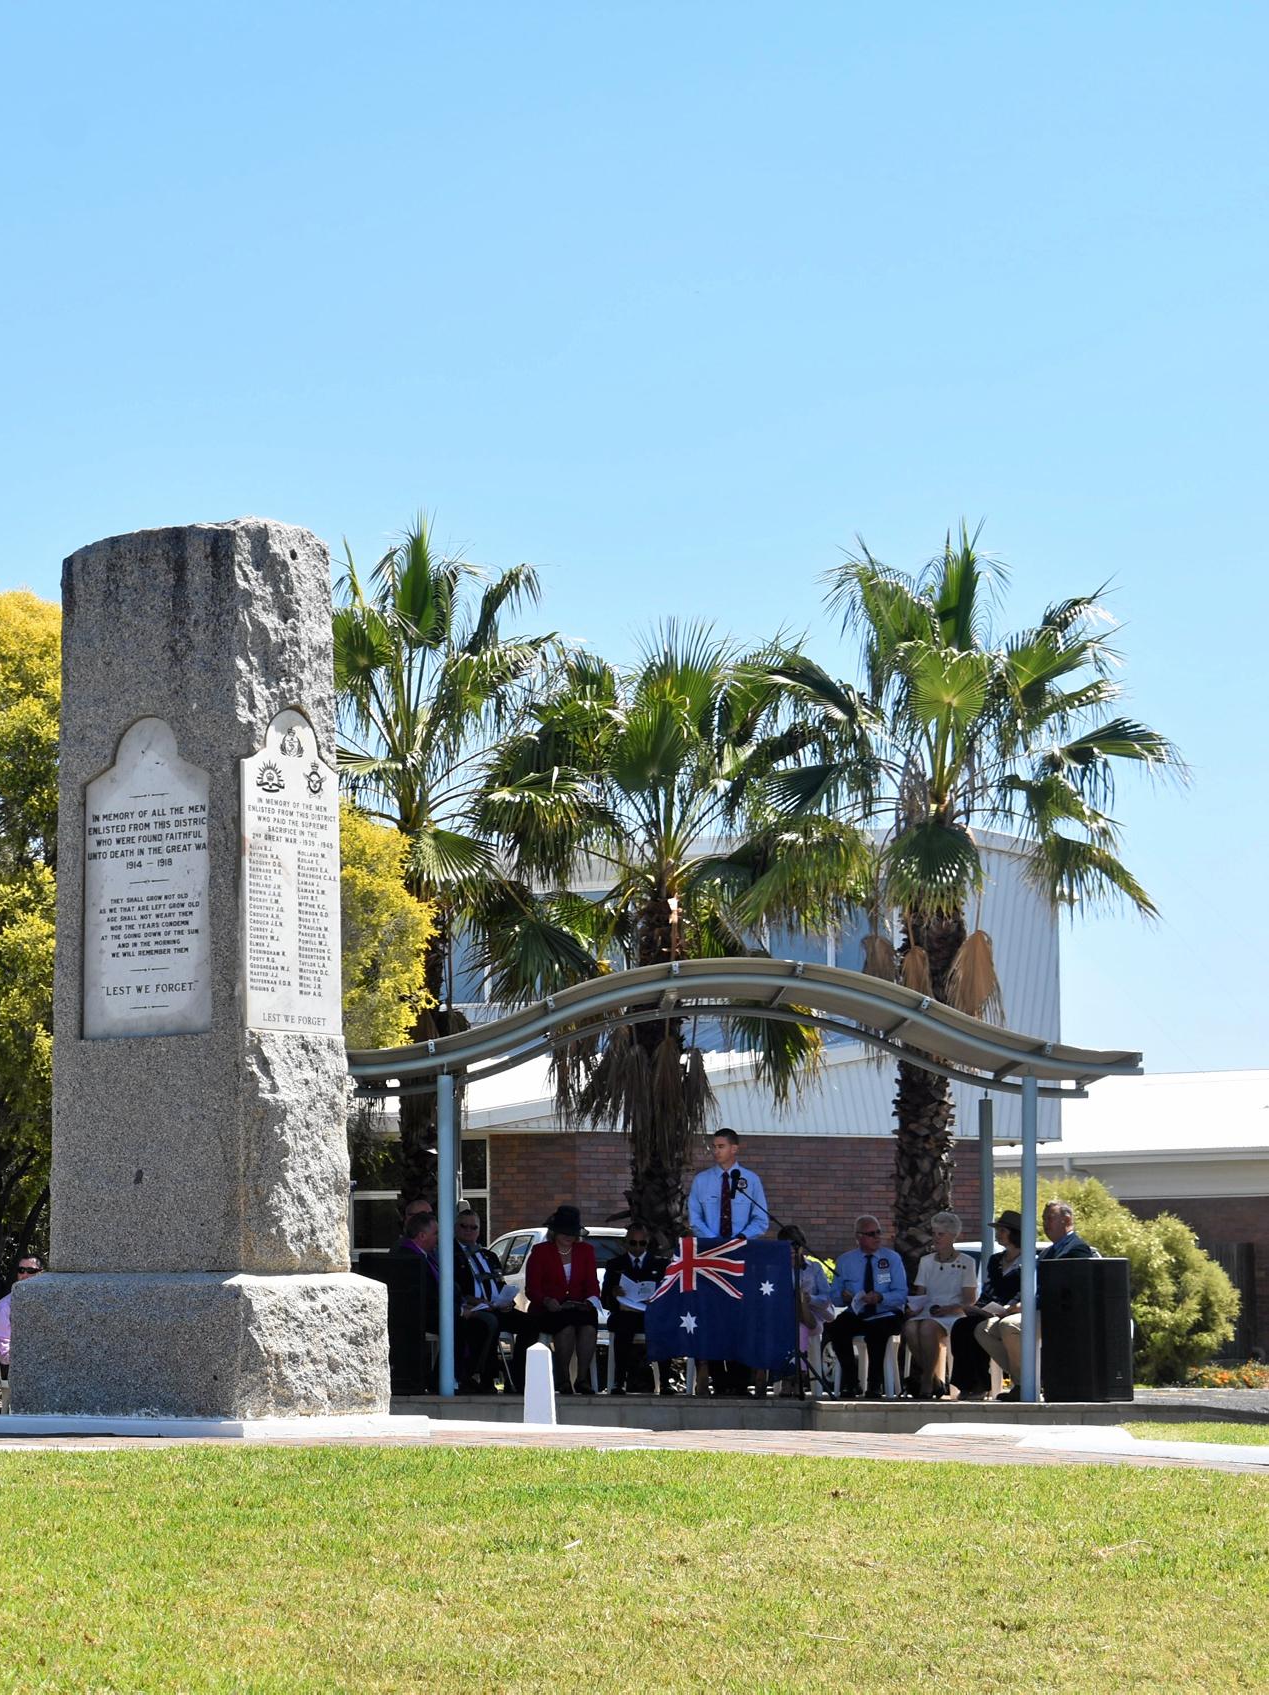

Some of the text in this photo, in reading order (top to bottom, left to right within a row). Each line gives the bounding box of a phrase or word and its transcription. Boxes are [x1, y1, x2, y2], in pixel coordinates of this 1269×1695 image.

[266, 798, 289, 807] MEMORY
[92, 814, 99, 822] IN
[102, 811, 134, 821] MEMORY
[138, 810, 147, 818] OF
[170, 806, 184, 815] THE
[188, 804, 205, 813] MEN
[248, 805, 275, 814] ENLISTED
[296, 811, 308, 819] THIS
[311, 814, 335, 822] DISTRICT
[88, 817, 207, 835] ENLISTED FROM THIS DISTRIC
[268, 826, 296, 835] SACRIFICE
[302, 821, 327, 830] SUPREME
[96, 831, 202, 846] WHO WERE FOUND FAITHFUL
[264, 834, 282, 842] GREAT
[88, 852, 107, 860] UNTO
[110, 849, 134, 858] DEATH
[137, 848, 144, 856] IN
[148, 846, 162, 855] THE
[165, 844, 192, 854] GREAT
[126, 860, 142, 869] 1914
[157, 858, 173, 867] 1918
[138, 948, 171, 956] REMEMBER
[136, 984, 150, 993] WE
[263, 1012, 327, 1026] LEST WE FORGET
